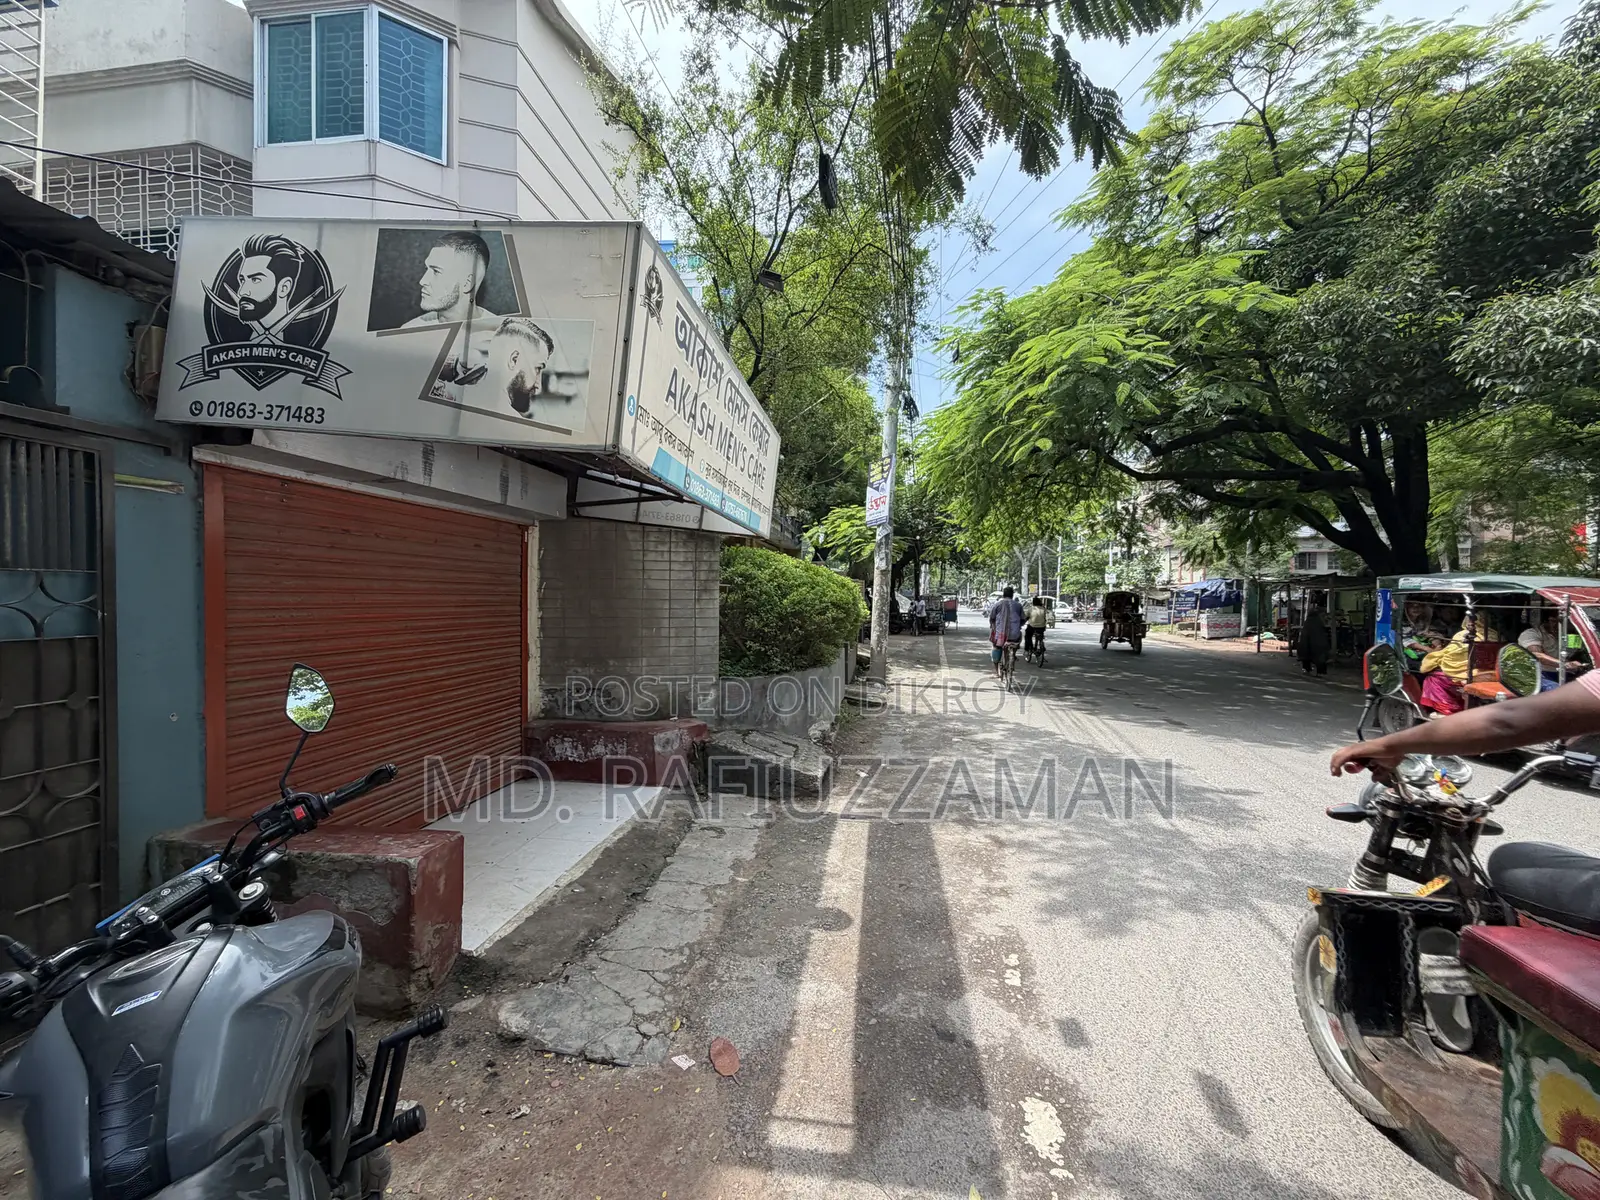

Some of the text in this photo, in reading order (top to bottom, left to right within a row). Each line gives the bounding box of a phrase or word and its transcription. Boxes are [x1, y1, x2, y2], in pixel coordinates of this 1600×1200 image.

[212, 347, 318, 370] AKASH MEN'S CARE
[674, 300, 724, 401] আকাশ
[723, 377, 750, 431] মেনস
[206, 400, 325, 424] 01863-371483
[665, 367, 767, 490] AKASH MEN'S CARE
